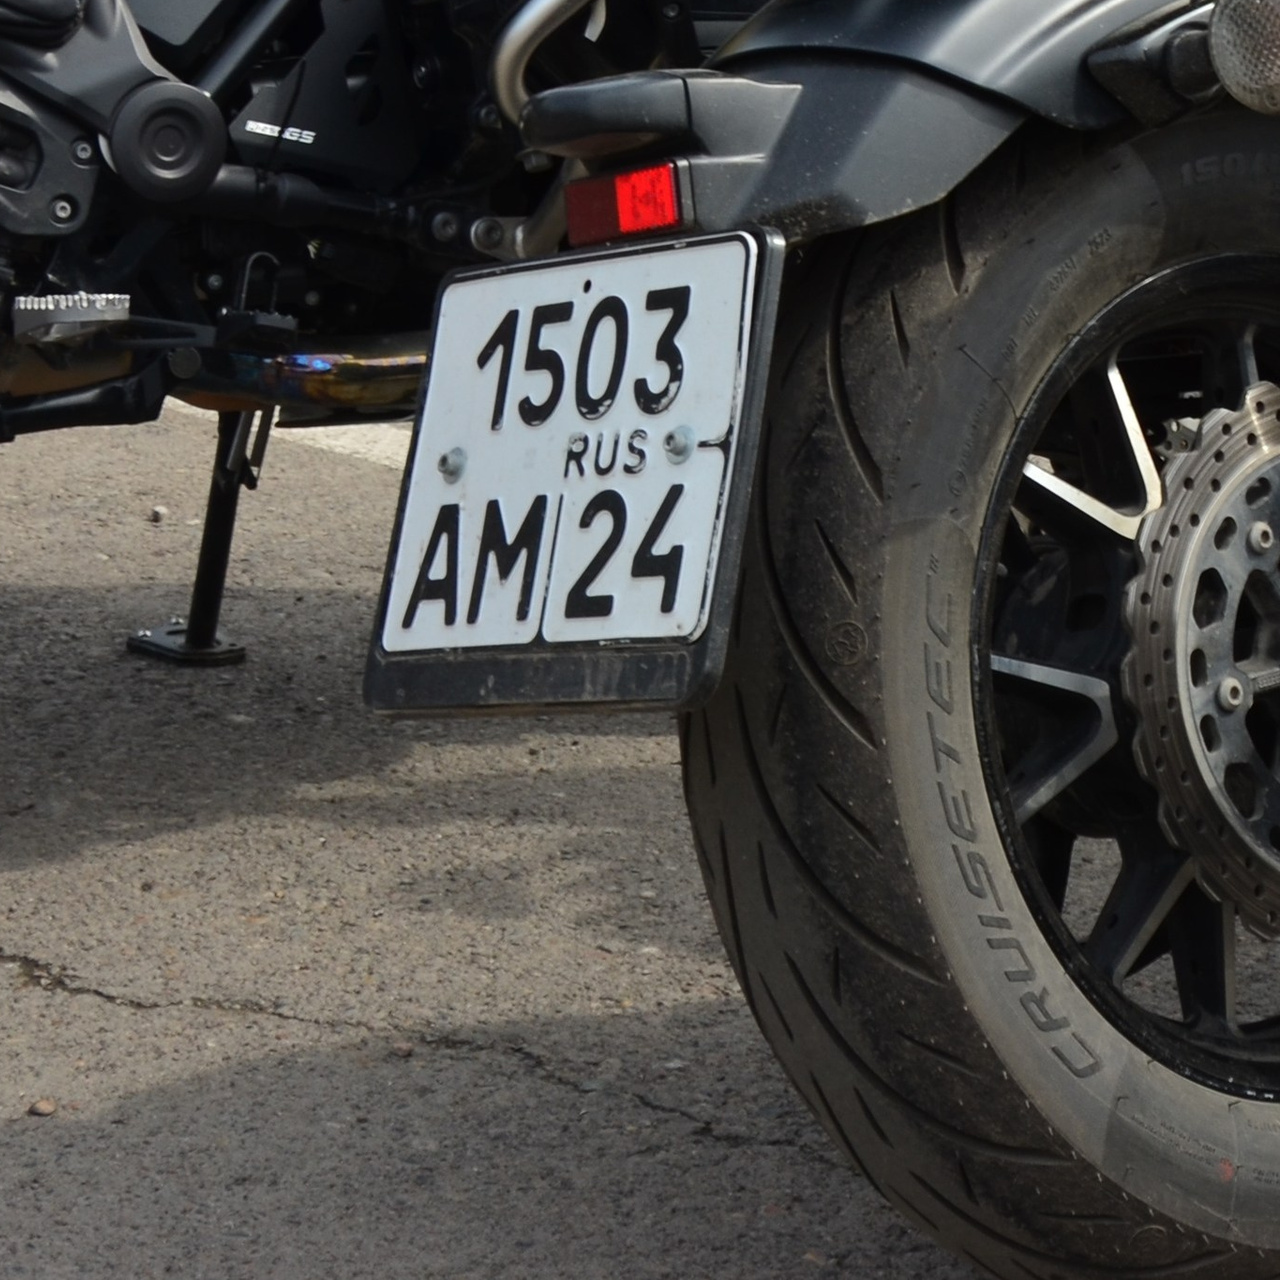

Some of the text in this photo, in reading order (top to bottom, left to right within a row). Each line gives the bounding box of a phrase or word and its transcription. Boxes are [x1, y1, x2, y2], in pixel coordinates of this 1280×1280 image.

[478, 286, 692, 431] 1503
[564, 429, 648, 478] RUS
[564, 483, 685, 619] 24
[924, 570, 1103, 1079] CRUISETEC
